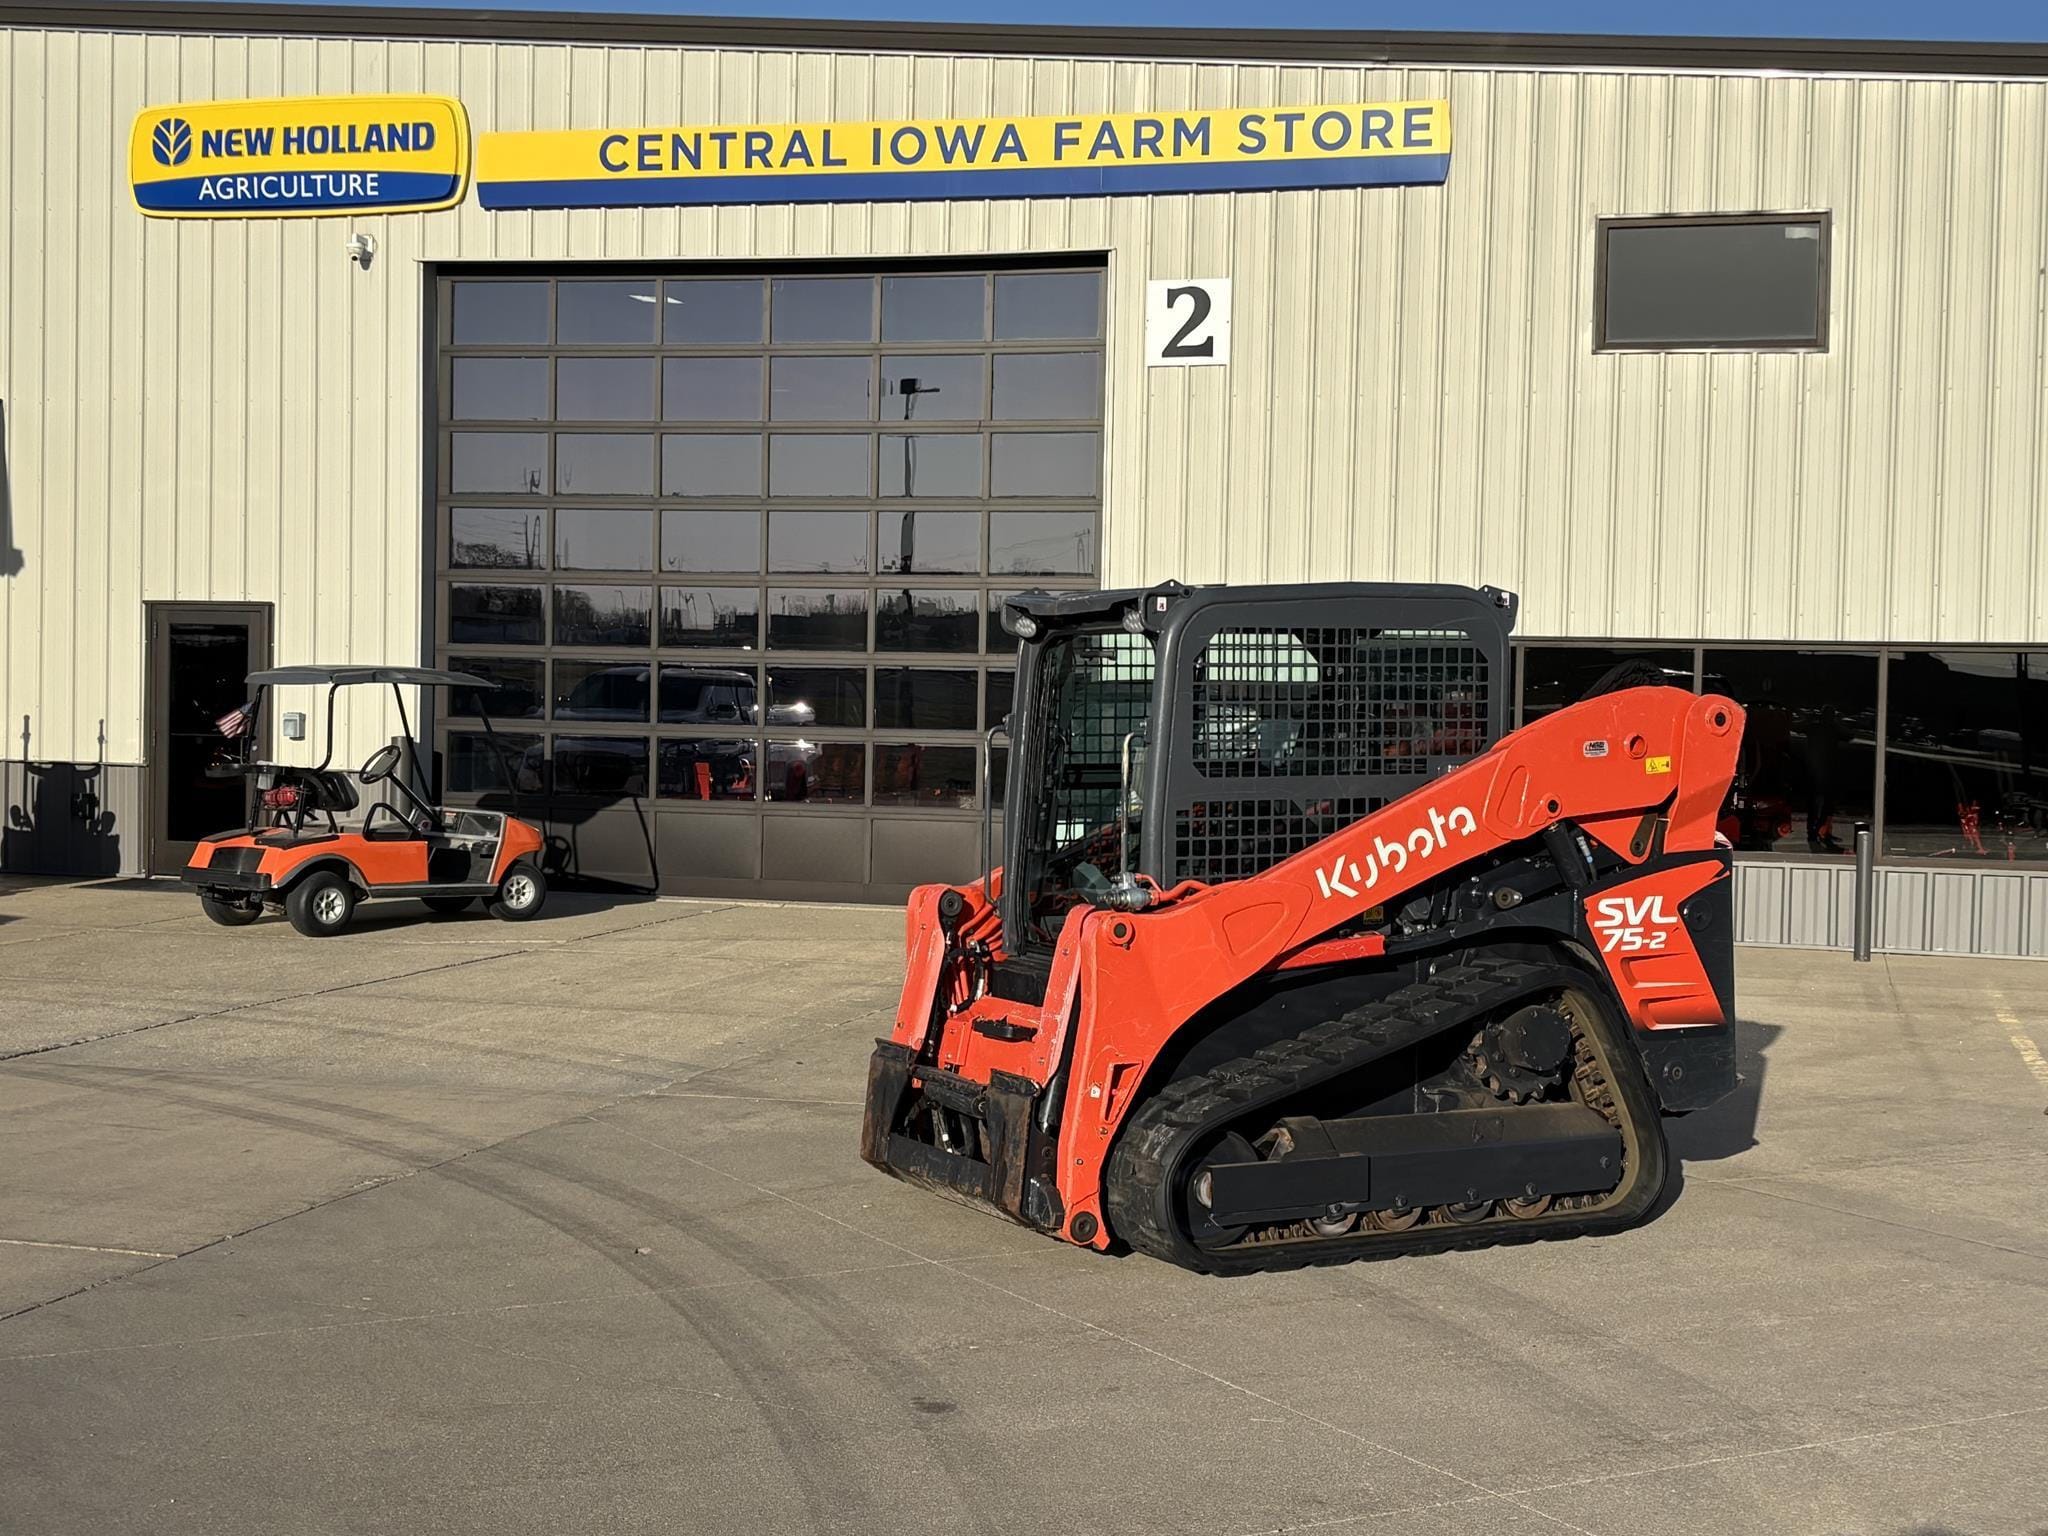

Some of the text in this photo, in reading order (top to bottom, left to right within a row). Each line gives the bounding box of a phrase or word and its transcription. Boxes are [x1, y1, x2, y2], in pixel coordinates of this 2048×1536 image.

[201, 123, 434, 157] NEW HOLLAND
[600, 107, 1434, 171] CENTRAL IOWA FARM STORE
[198, 174, 379, 200] AGRICULTURE
[1162, 285, 1213, 357] 2
[1315, 806, 1476, 898] Kubota
[1594, 896, 1677, 927] SVL
[1602, 927, 1667, 952] 75-2
